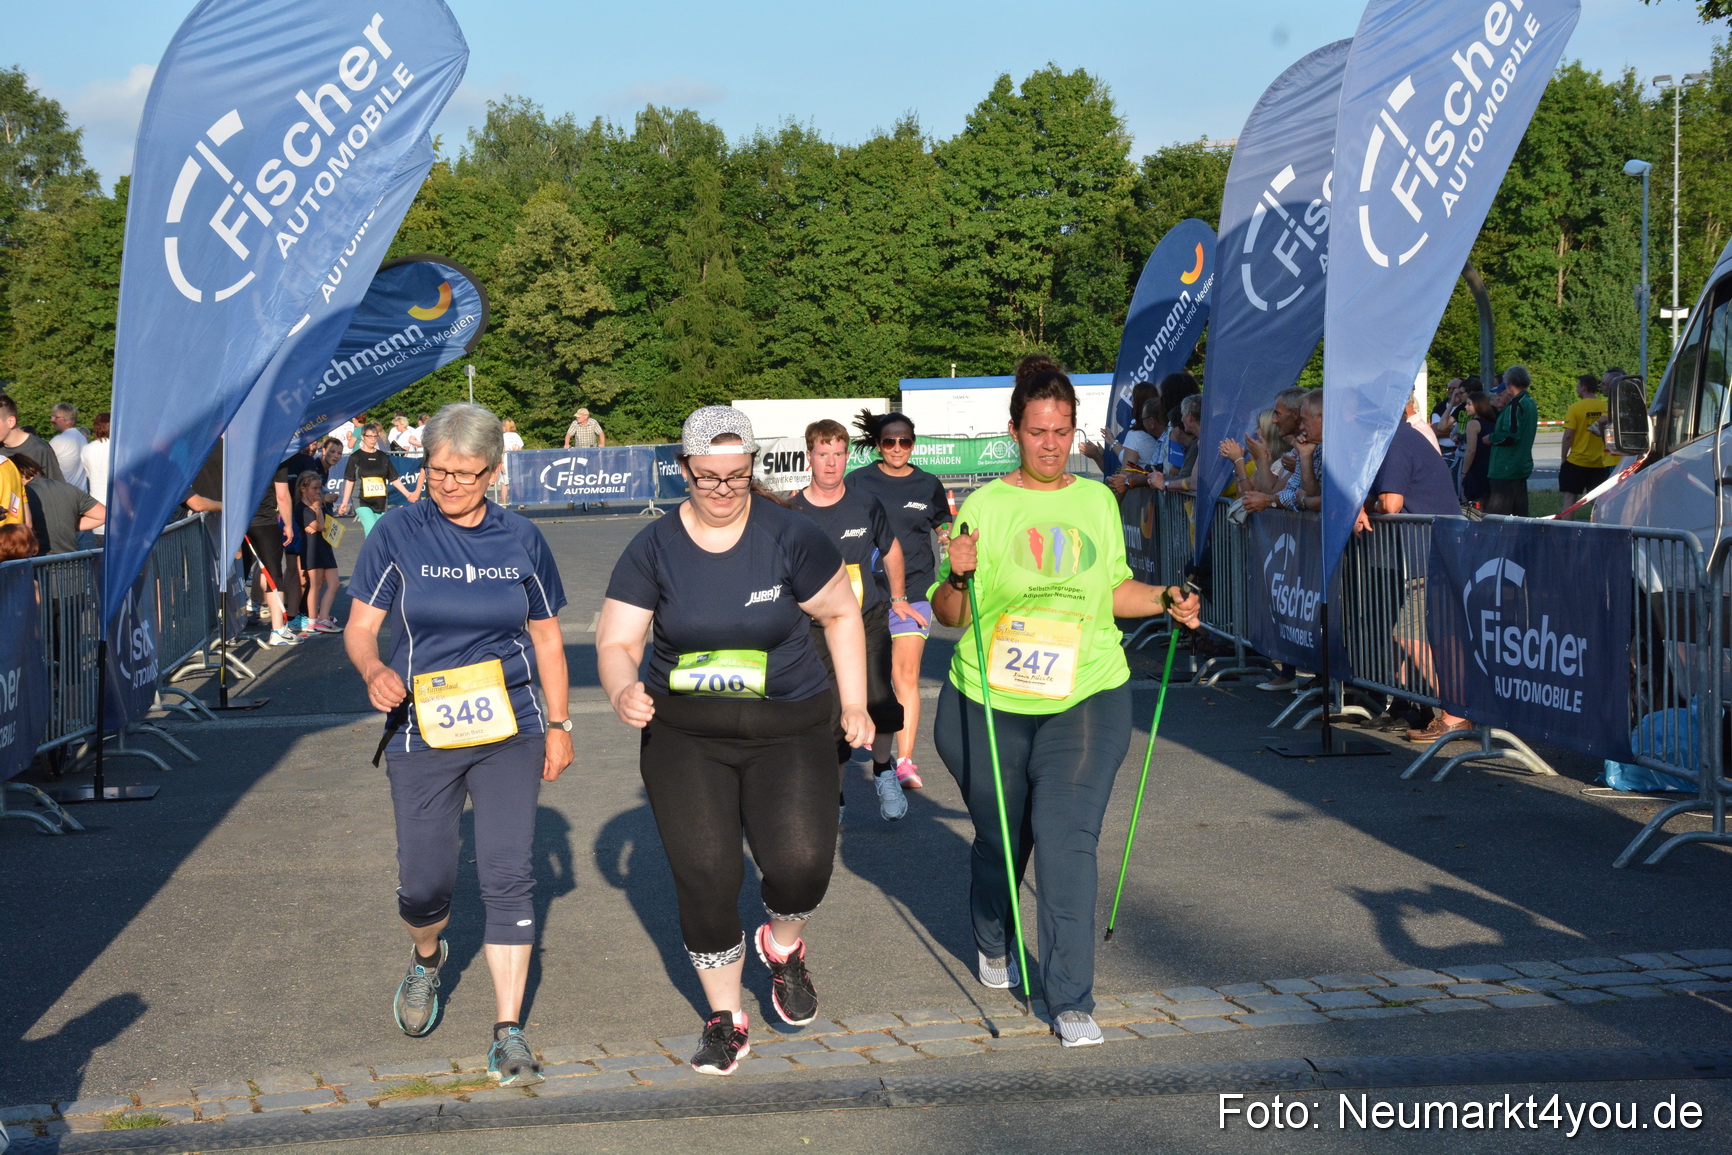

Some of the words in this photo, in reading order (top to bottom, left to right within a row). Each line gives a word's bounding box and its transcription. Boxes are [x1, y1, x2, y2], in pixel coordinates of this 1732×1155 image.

[1441, 12, 1540, 218] AUTOMOBILE
[209, 12, 392, 261] Fischer
[275, 62, 414, 259] AUTOMOBILE
[1272, 169, 1333, 277] Fisc
[1168, 323, 1186, 351] Druck
[1185, 305, 1197, 324] und
[373, 352, 409, 376] Druck
[409, 340, 432, 357] und
[433, 313, 475, 343] Medien
[1119, 290, 1191, 408] Frischmann
[907, 456, 928, 466] ESTEN
[930, 454, 961, 465] HÄNDEN
[911, 443, 955, 456] NDHEIT
[979, 441, 1018, 459] AOK
[557, 470, 631, 486] Fischer
[658, 460, 682, 476] Frisch
[564, 486, 626, 495] AUTOMOBILE
[421, 565, 463, 579] EURO
[479, 567, 520, 579] POLES
[1271, 573, 1320, 622] Fischer
[1279, 623, 1314, 648] AUTOMOBILE
[1480, 610, 1587, 678] Fischer
[1005, 647, 1059, 676] 247
[689, 673, 745, 692] 700
[1494, 675, 1583, 714] AUTOMOBILE
[436, 697, 493, 729] 348
